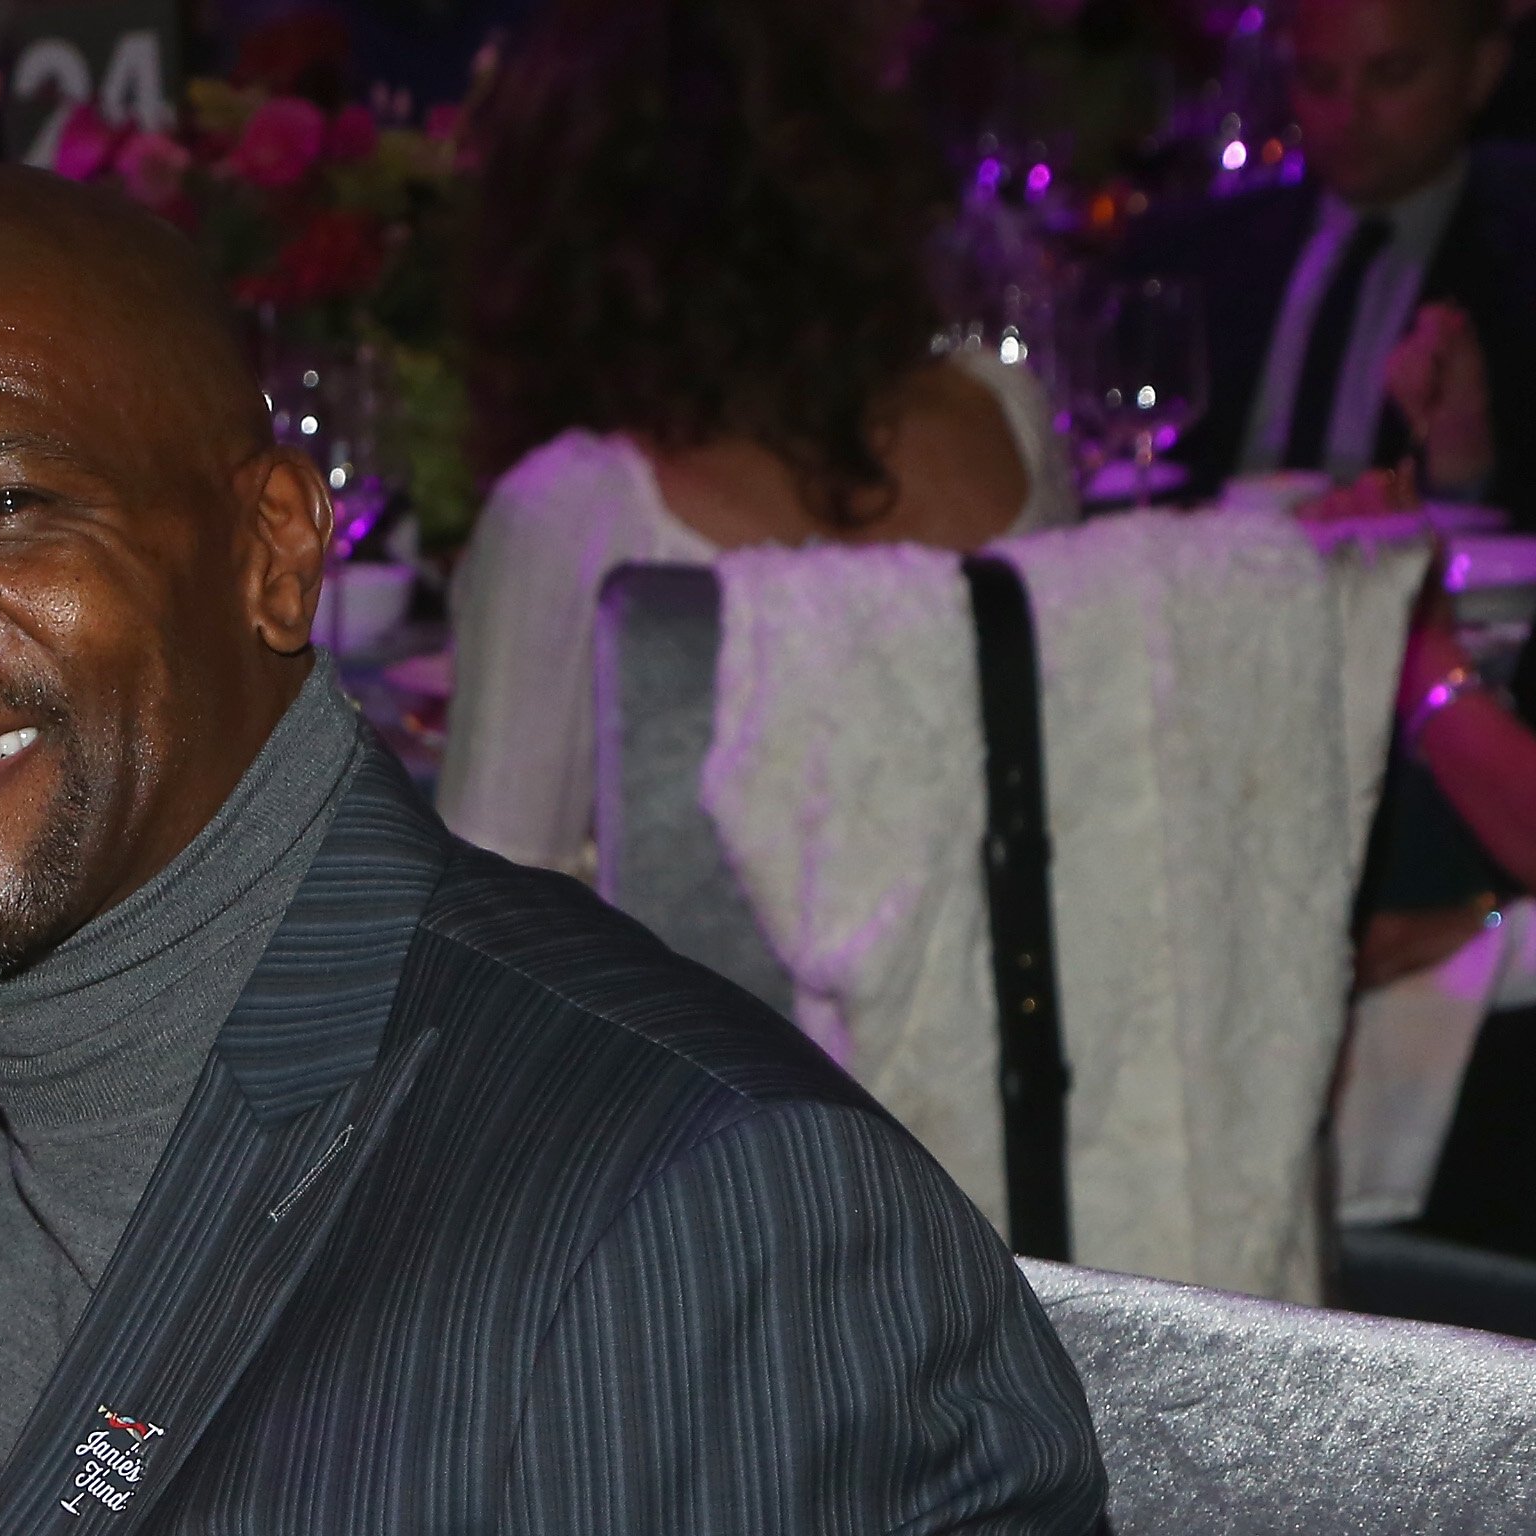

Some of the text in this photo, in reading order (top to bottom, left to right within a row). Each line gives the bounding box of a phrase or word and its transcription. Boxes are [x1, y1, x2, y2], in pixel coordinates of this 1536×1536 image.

[12, 30, 178, 169] 24
[74, 1430, 142, 1483] Janie's
[74, 1460, 135, 1512] Fund
